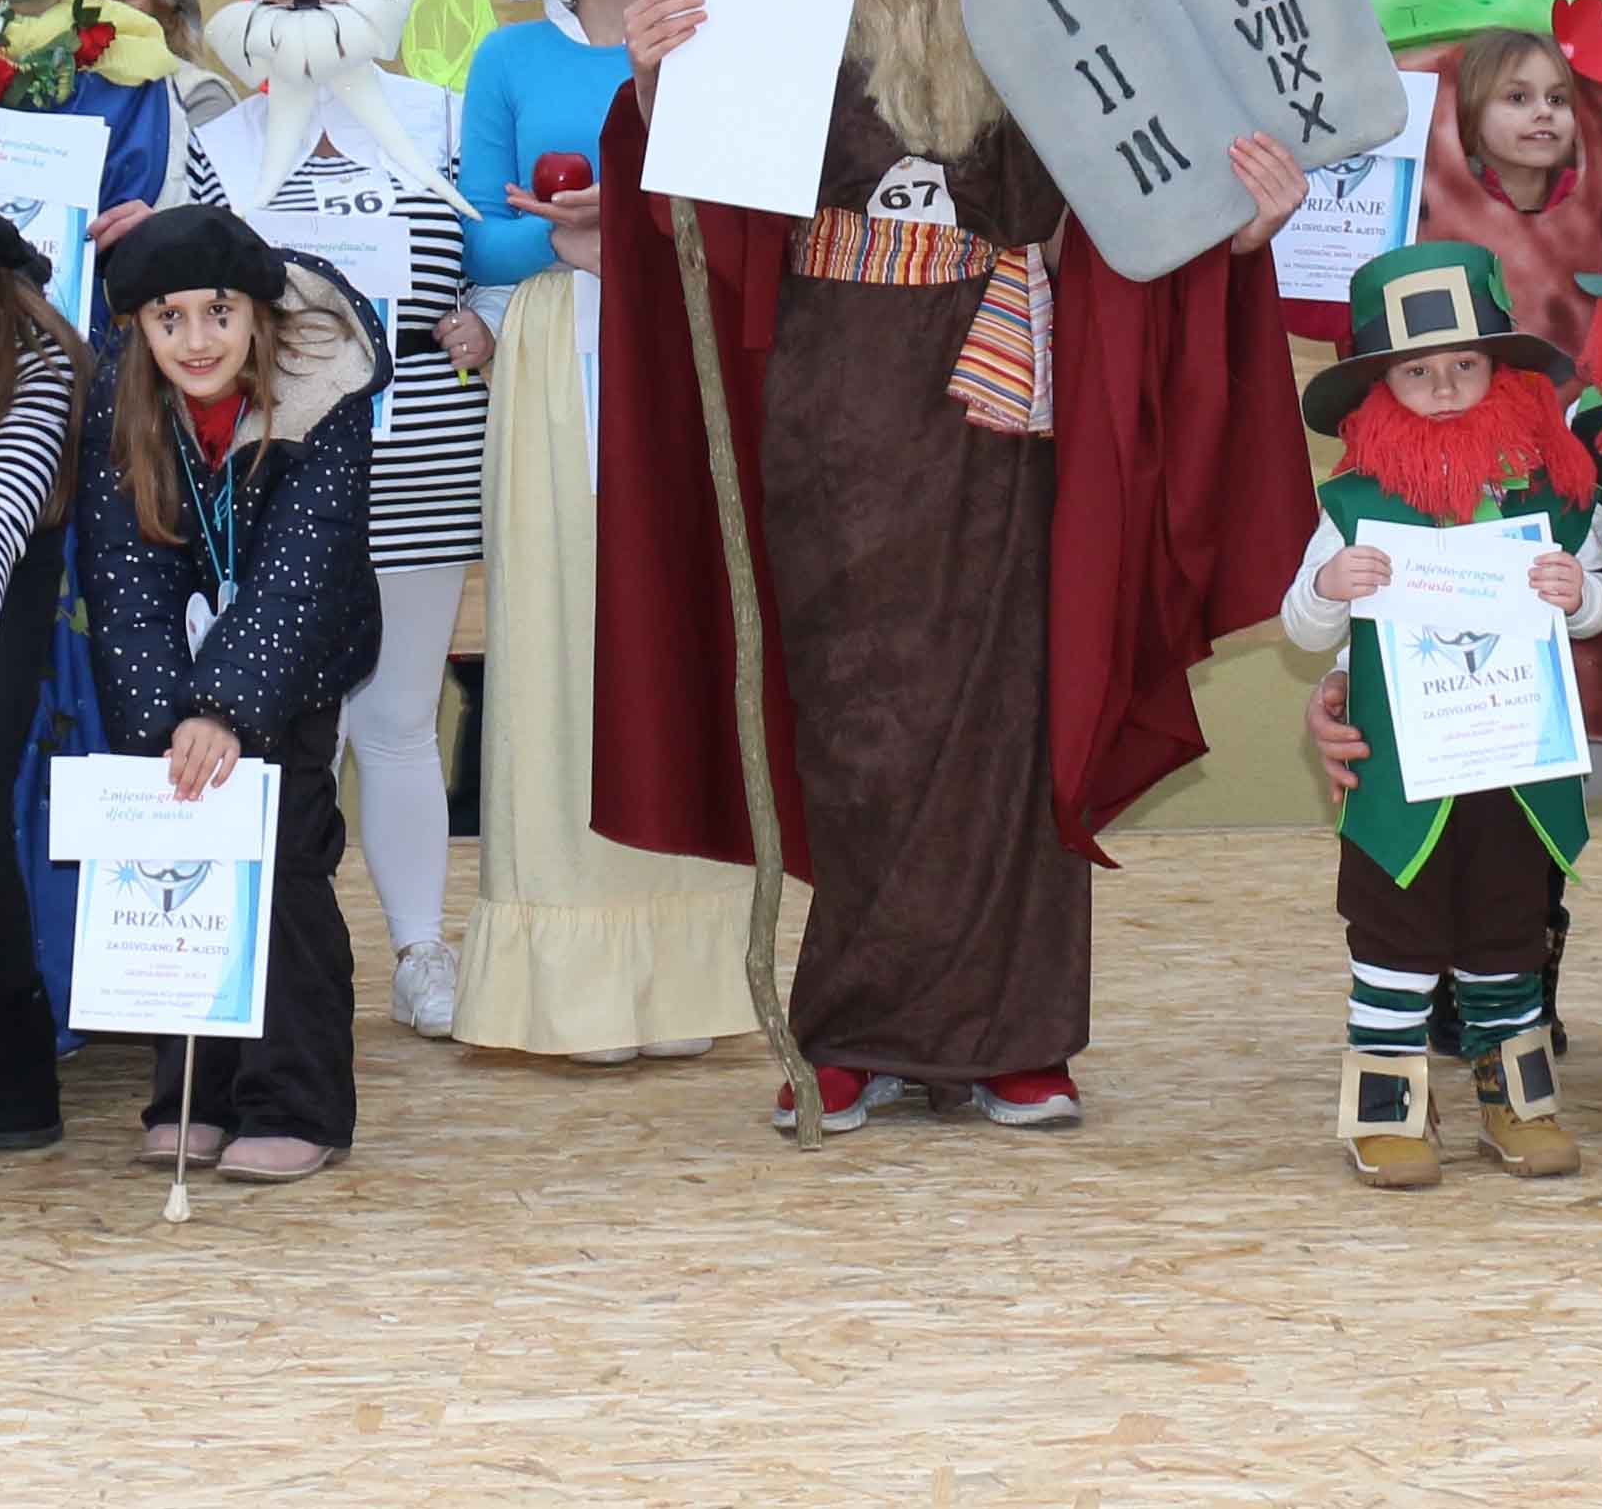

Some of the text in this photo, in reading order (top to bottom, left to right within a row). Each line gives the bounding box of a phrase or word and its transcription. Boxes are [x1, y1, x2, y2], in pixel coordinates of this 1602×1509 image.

[1074, 43, 1136, 115] II
[1267, 43, 1323, 94] IX
[1289, 91, 1337, 143] X
[1115, 116, 1192, 197] III
[324, 190, 383, 216] 56
[879, 180, 942, 212] 67
[1422, 663, 1534, 697] PRIZNANJE
[111, 909, 229, 933] PRIZNANJE
